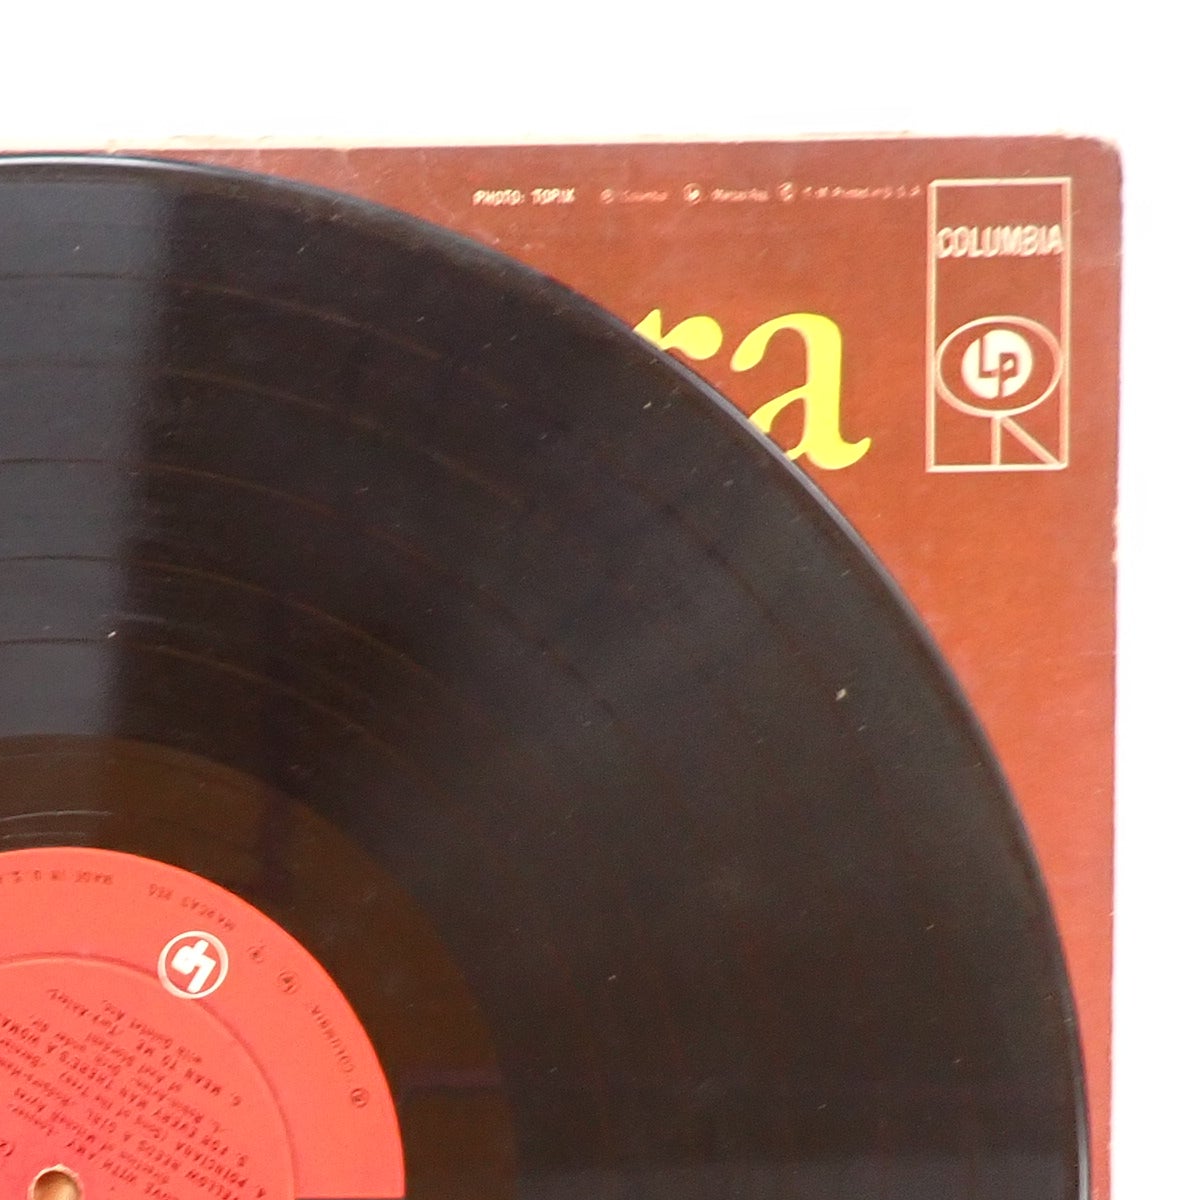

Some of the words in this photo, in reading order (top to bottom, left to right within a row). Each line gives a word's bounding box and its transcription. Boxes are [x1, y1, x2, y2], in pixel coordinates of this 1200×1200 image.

[935, 224, 1063, 259] COLUMBIA
[134, 1038, 157, 1058] ME
[158, 1052, 180, 1072] TO
[116, 1083, 150, 1111] MAN
[182, 1066, 224, 1098] MEAN
[151, 1103, 199, 1140] EVERY
[134, 1137, 182, 1173] NEEDS
[199, 1131, 230, 1158] FOR
[172, 1138, 248, 1191] POINCIANA
